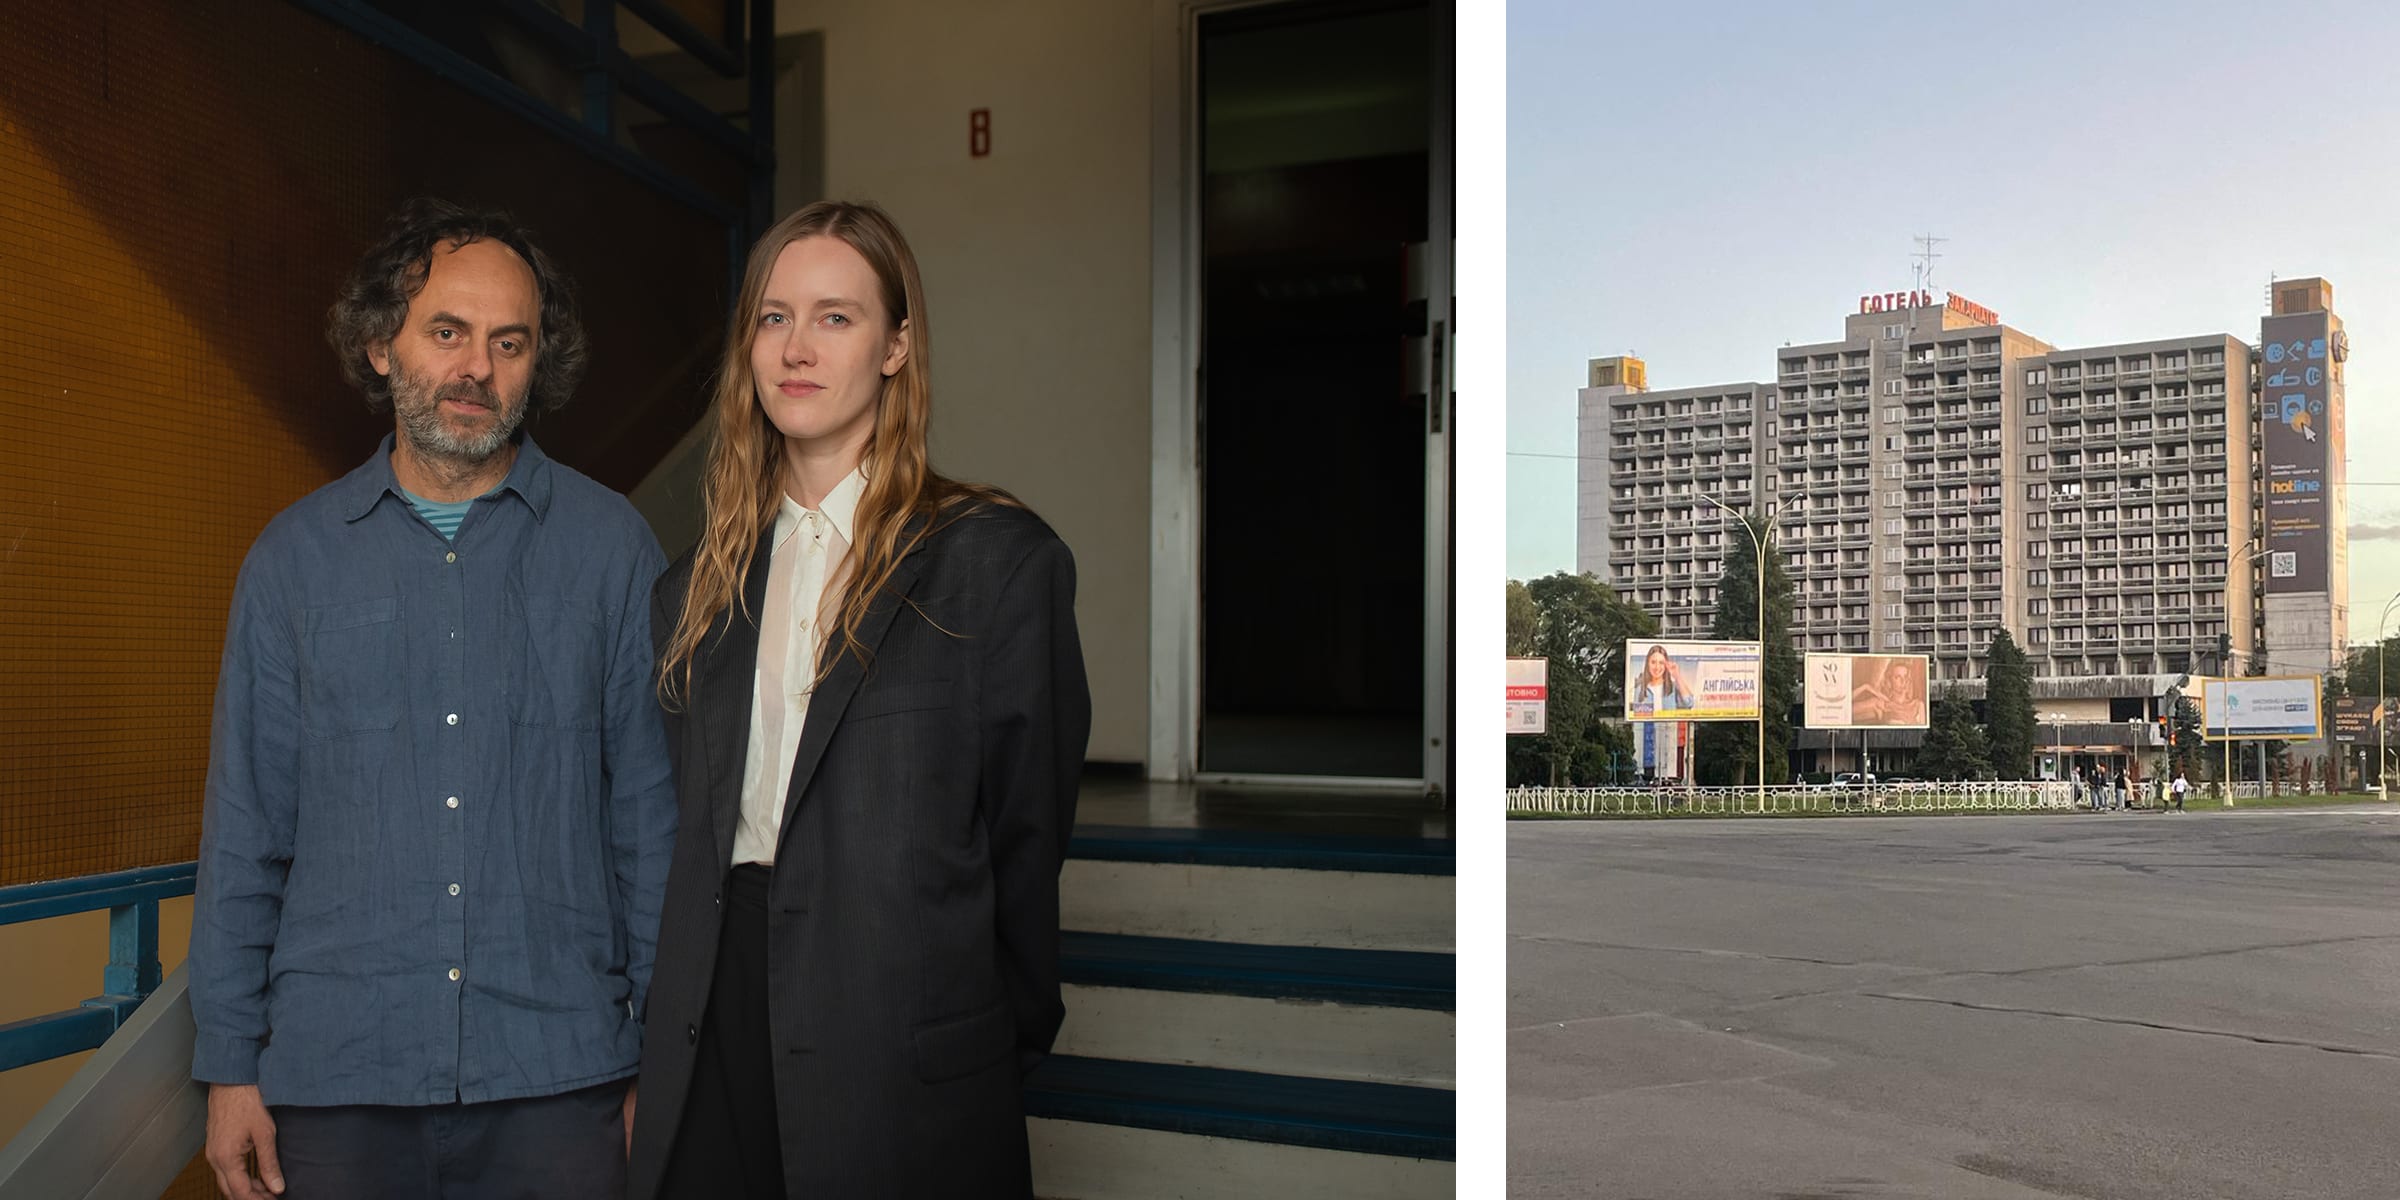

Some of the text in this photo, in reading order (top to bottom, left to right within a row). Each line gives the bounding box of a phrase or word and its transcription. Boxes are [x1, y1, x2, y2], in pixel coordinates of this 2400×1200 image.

[1860, 289, 1932, 315] ГОТЕЛЬ
[2270, 479, 2320, 493] hotline
[1703, 676, 1755, 692] АНГЛІЙСЬКА
